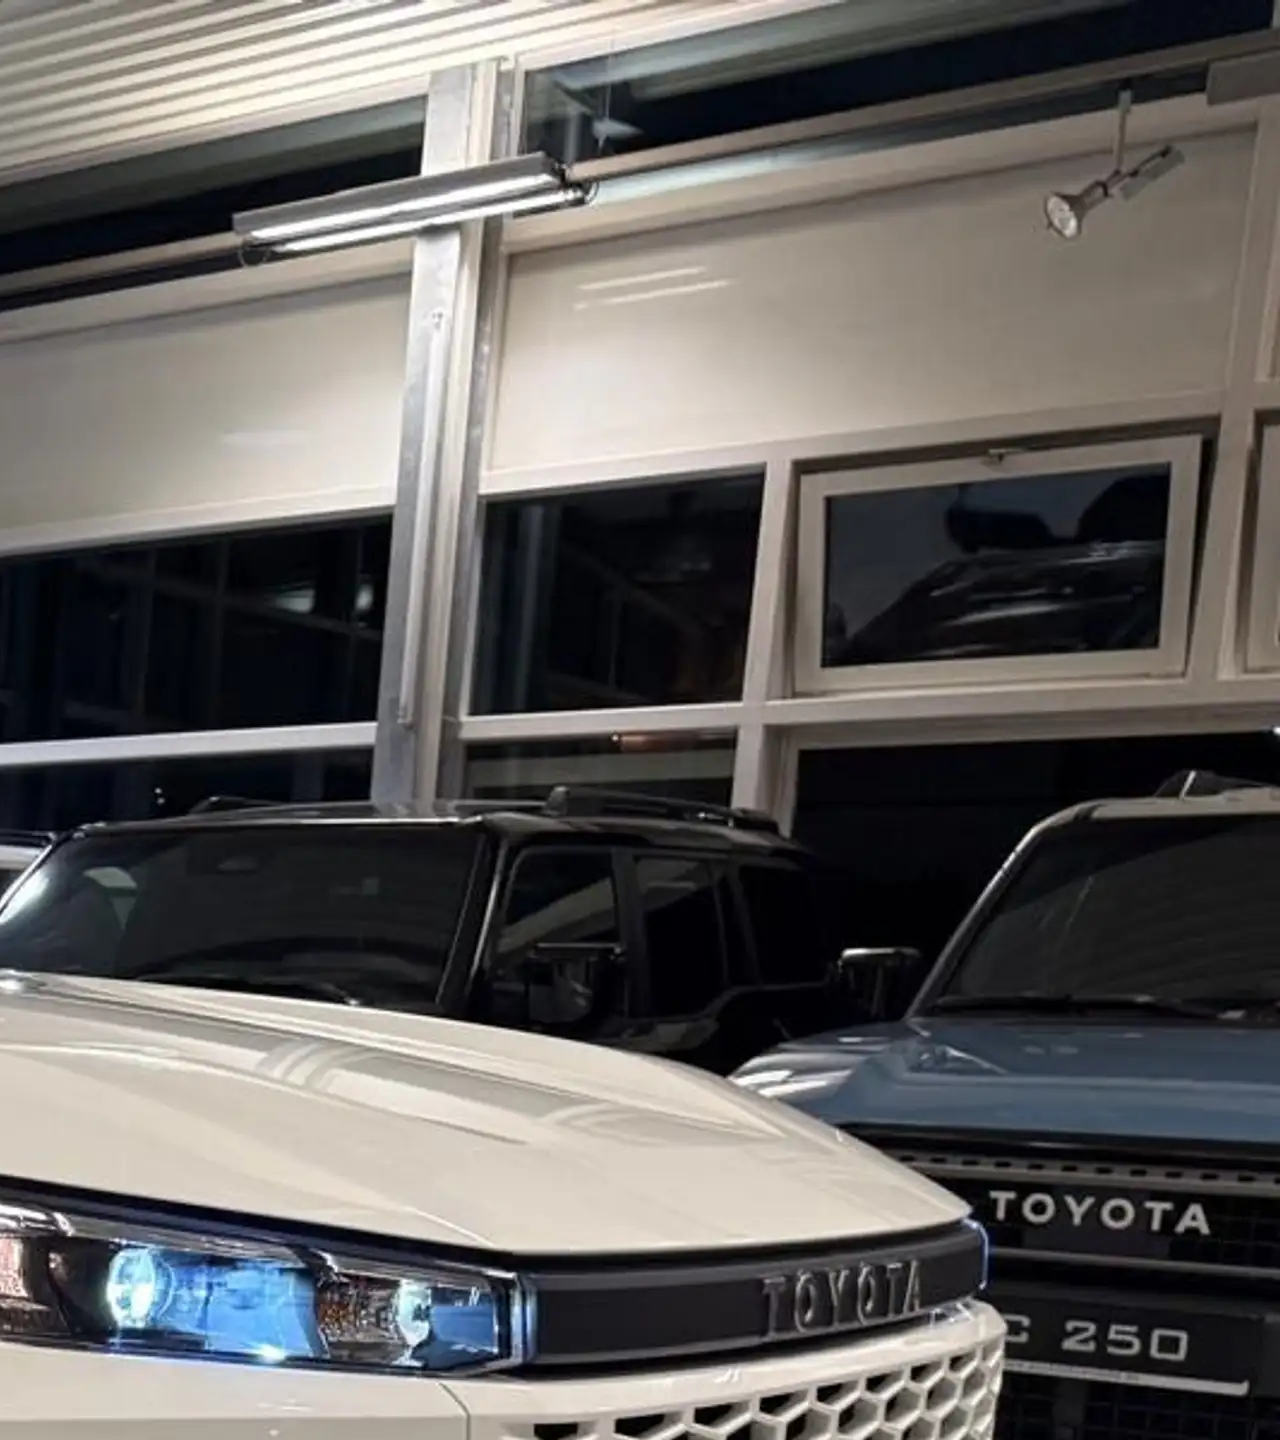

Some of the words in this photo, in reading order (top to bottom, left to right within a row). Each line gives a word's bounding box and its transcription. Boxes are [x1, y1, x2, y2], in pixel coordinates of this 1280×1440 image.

[989, 1190, 1211, 1236] TOYOTA
[762, 1259, 921, 1339] TOYOTA
[1003, 1313, 1031, 1343] C
[1060, 1319, 1189, 1362] 250
